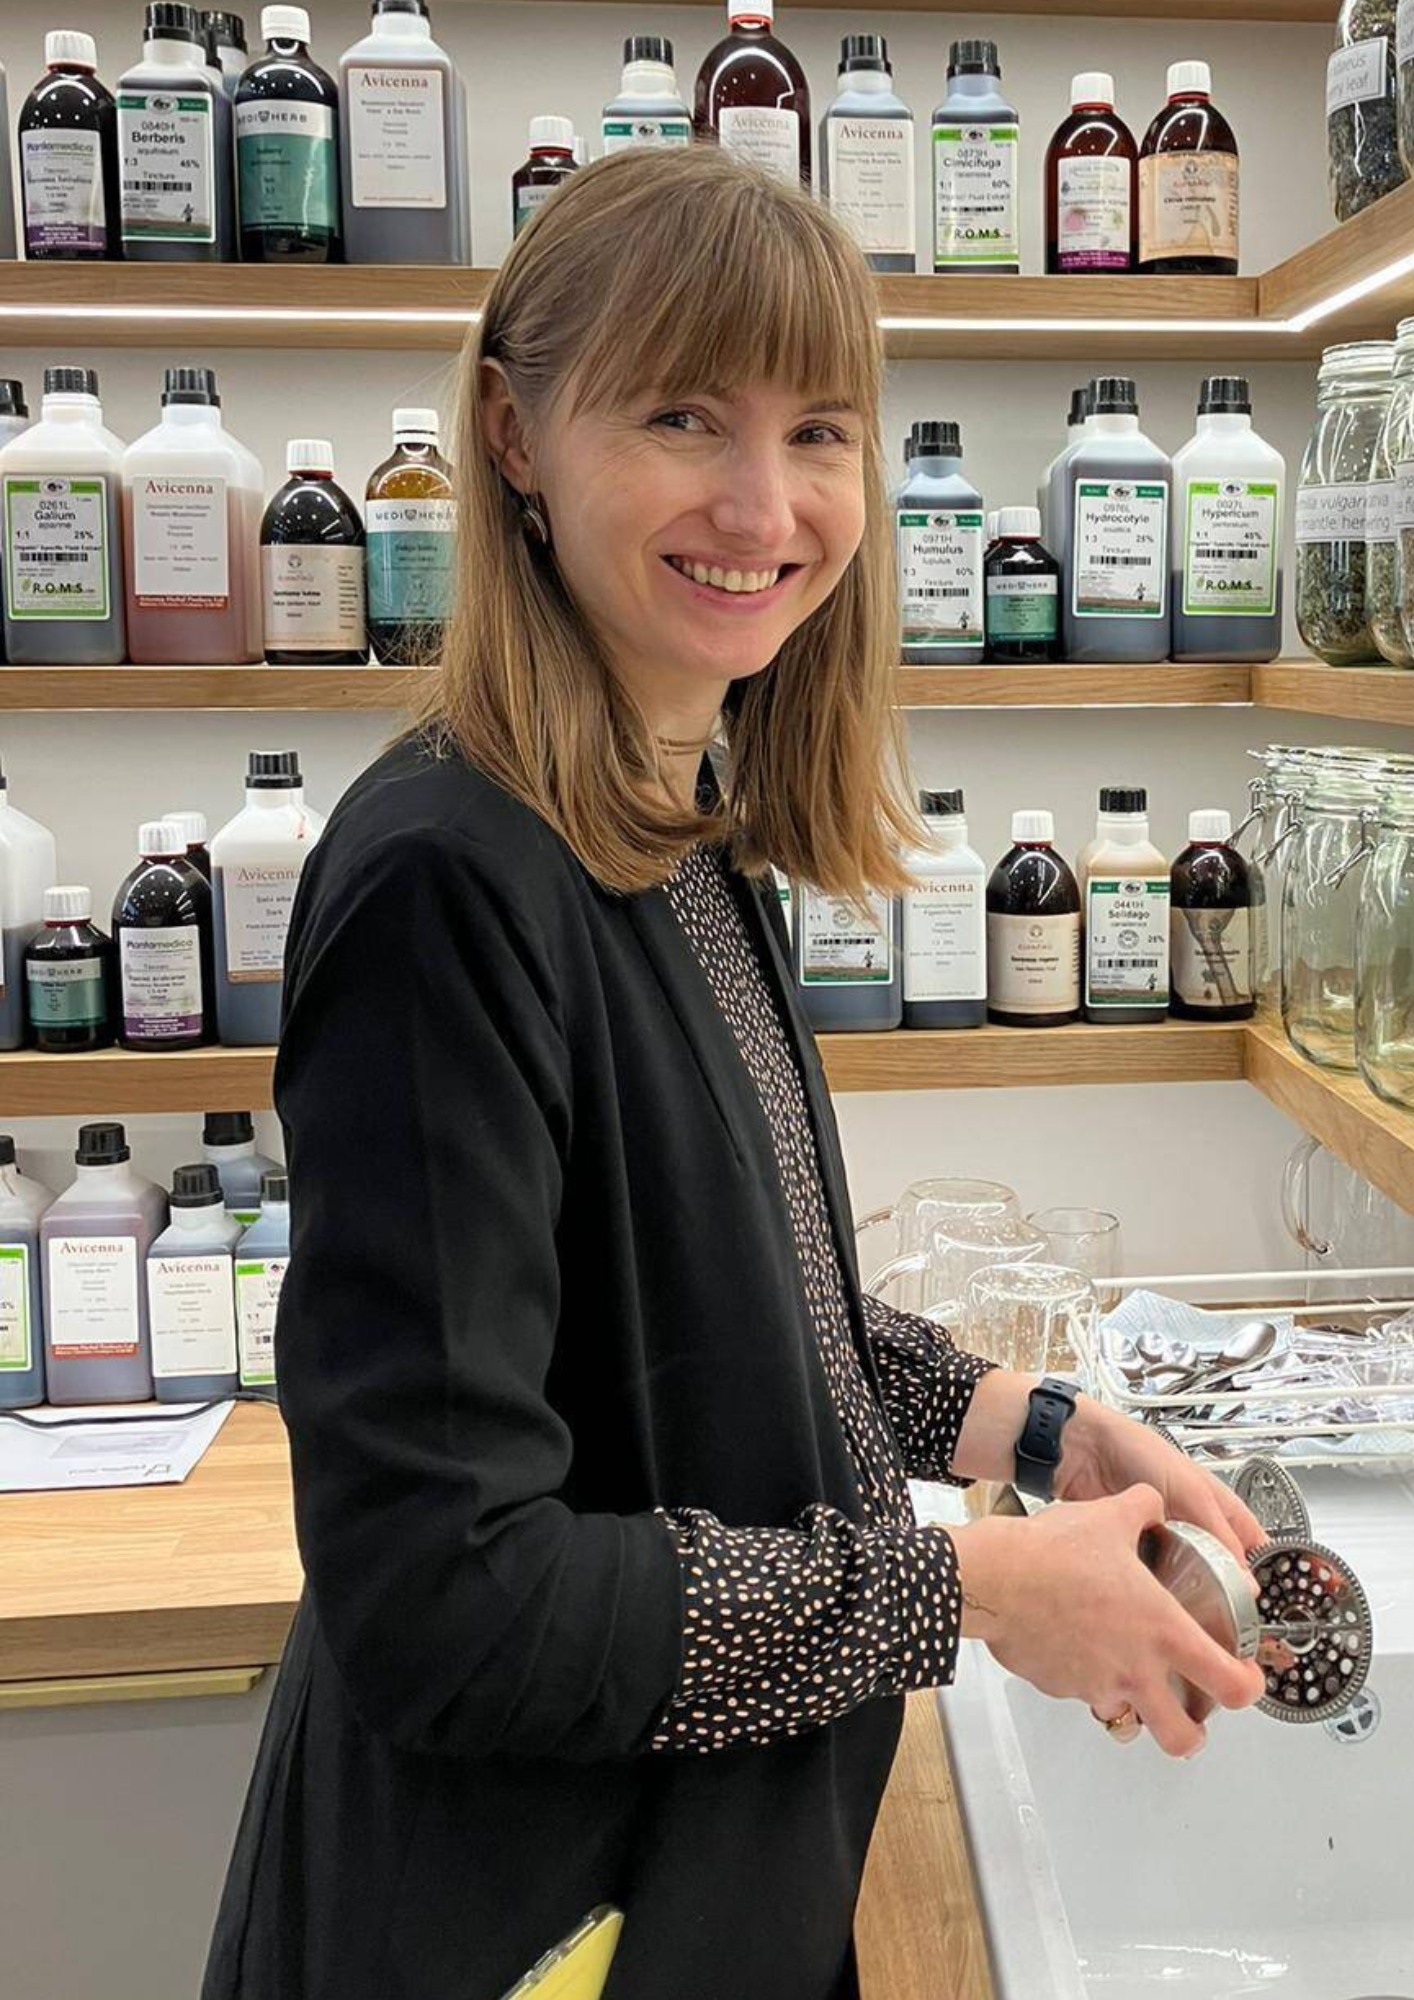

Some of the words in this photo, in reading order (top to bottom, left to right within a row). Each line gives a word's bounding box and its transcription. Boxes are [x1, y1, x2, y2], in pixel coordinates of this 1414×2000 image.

[362, 73, 429, 88] Avicenna
[271, 112, 308, 123] HERB
[131, 131, 186, 144] Berberis
[840, 124, 903, 140] Avicenna
[143, 171, 176, 180] Tincture
[145, 480, 214, 495] Avicenna
[34, 510, 76, 521] Galium
[376, 512, 403, 520] MEDI
[1086, 512, 1150, 525] Hydrocotyle
[1202, 509, 1259, 520] Hypericum
[74, 531, 94, 539] 25%
[913, 544, 964, 555] Humulus
[1103, 546, 1131, 554] Tincture
[1108, 910, 1150, 921] Solidago
[60, 1241, 123, 1254] Avicenna
[158, 1262, 220, 1274] Avicenna
